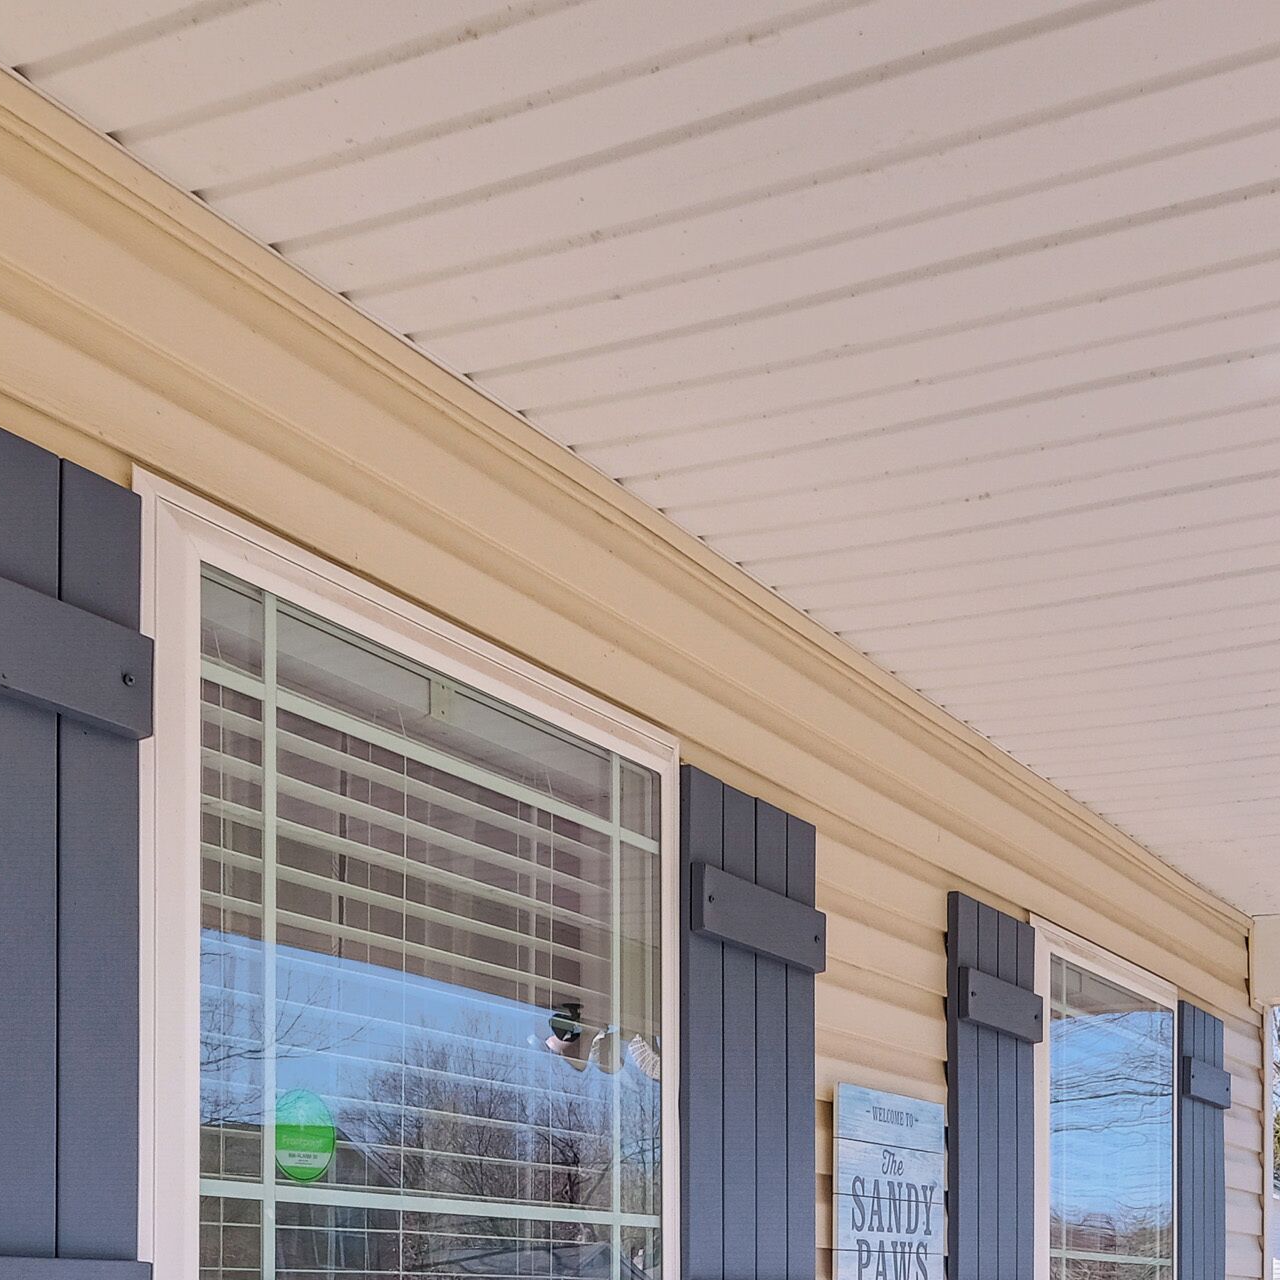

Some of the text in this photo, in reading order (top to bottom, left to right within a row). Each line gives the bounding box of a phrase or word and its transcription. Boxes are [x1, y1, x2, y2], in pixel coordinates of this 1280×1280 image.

[872, 1106, 914, 1128] WELCOME TO
[881, 1149, 904, 1176] The
[851, 1175, 935, 1236] SANDY
